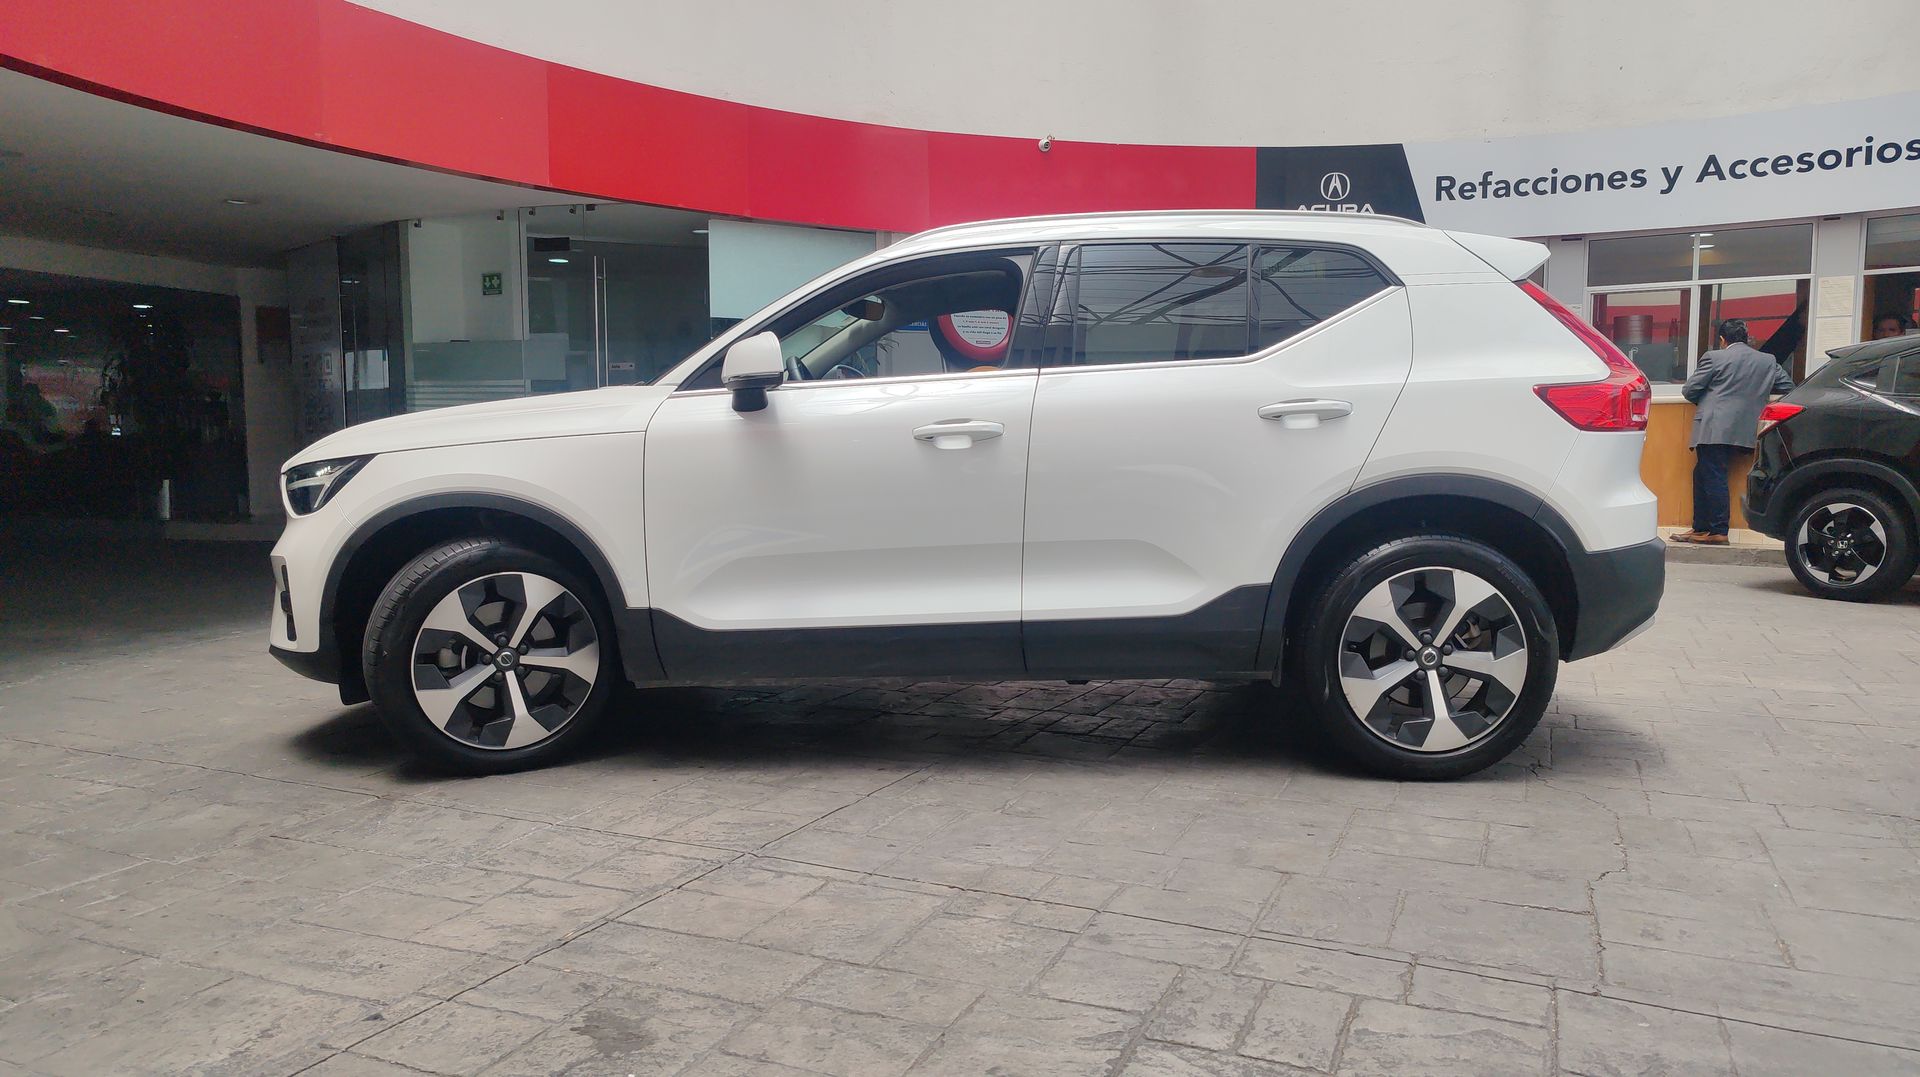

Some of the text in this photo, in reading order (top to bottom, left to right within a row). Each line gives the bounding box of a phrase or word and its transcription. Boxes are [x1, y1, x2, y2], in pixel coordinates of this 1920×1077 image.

[1435, 135, 1920, 201] Refacciones y Accesorios
